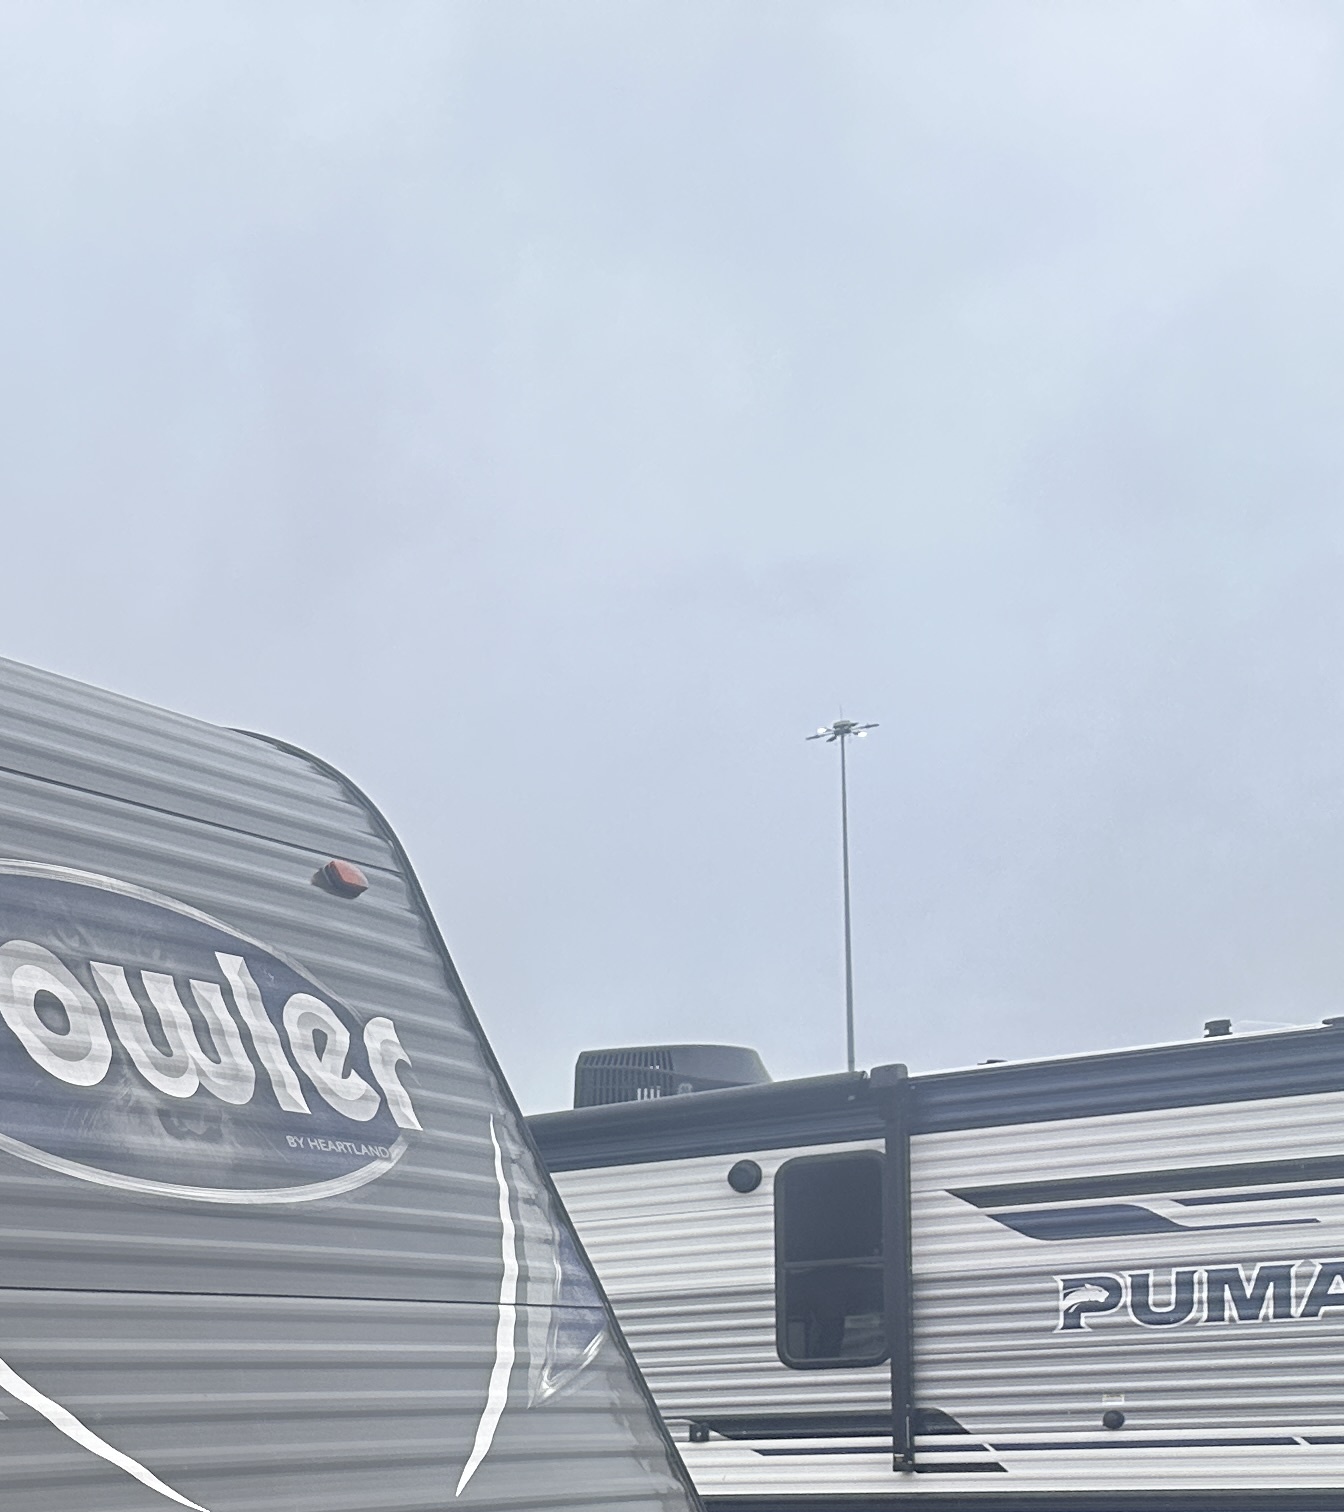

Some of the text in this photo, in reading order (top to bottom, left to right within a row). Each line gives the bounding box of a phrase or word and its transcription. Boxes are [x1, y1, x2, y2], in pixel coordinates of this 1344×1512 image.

[286, 1135, 390, 1158] BY HEARTLAND
[1052, 1257, 1344, 1333] PUMA
